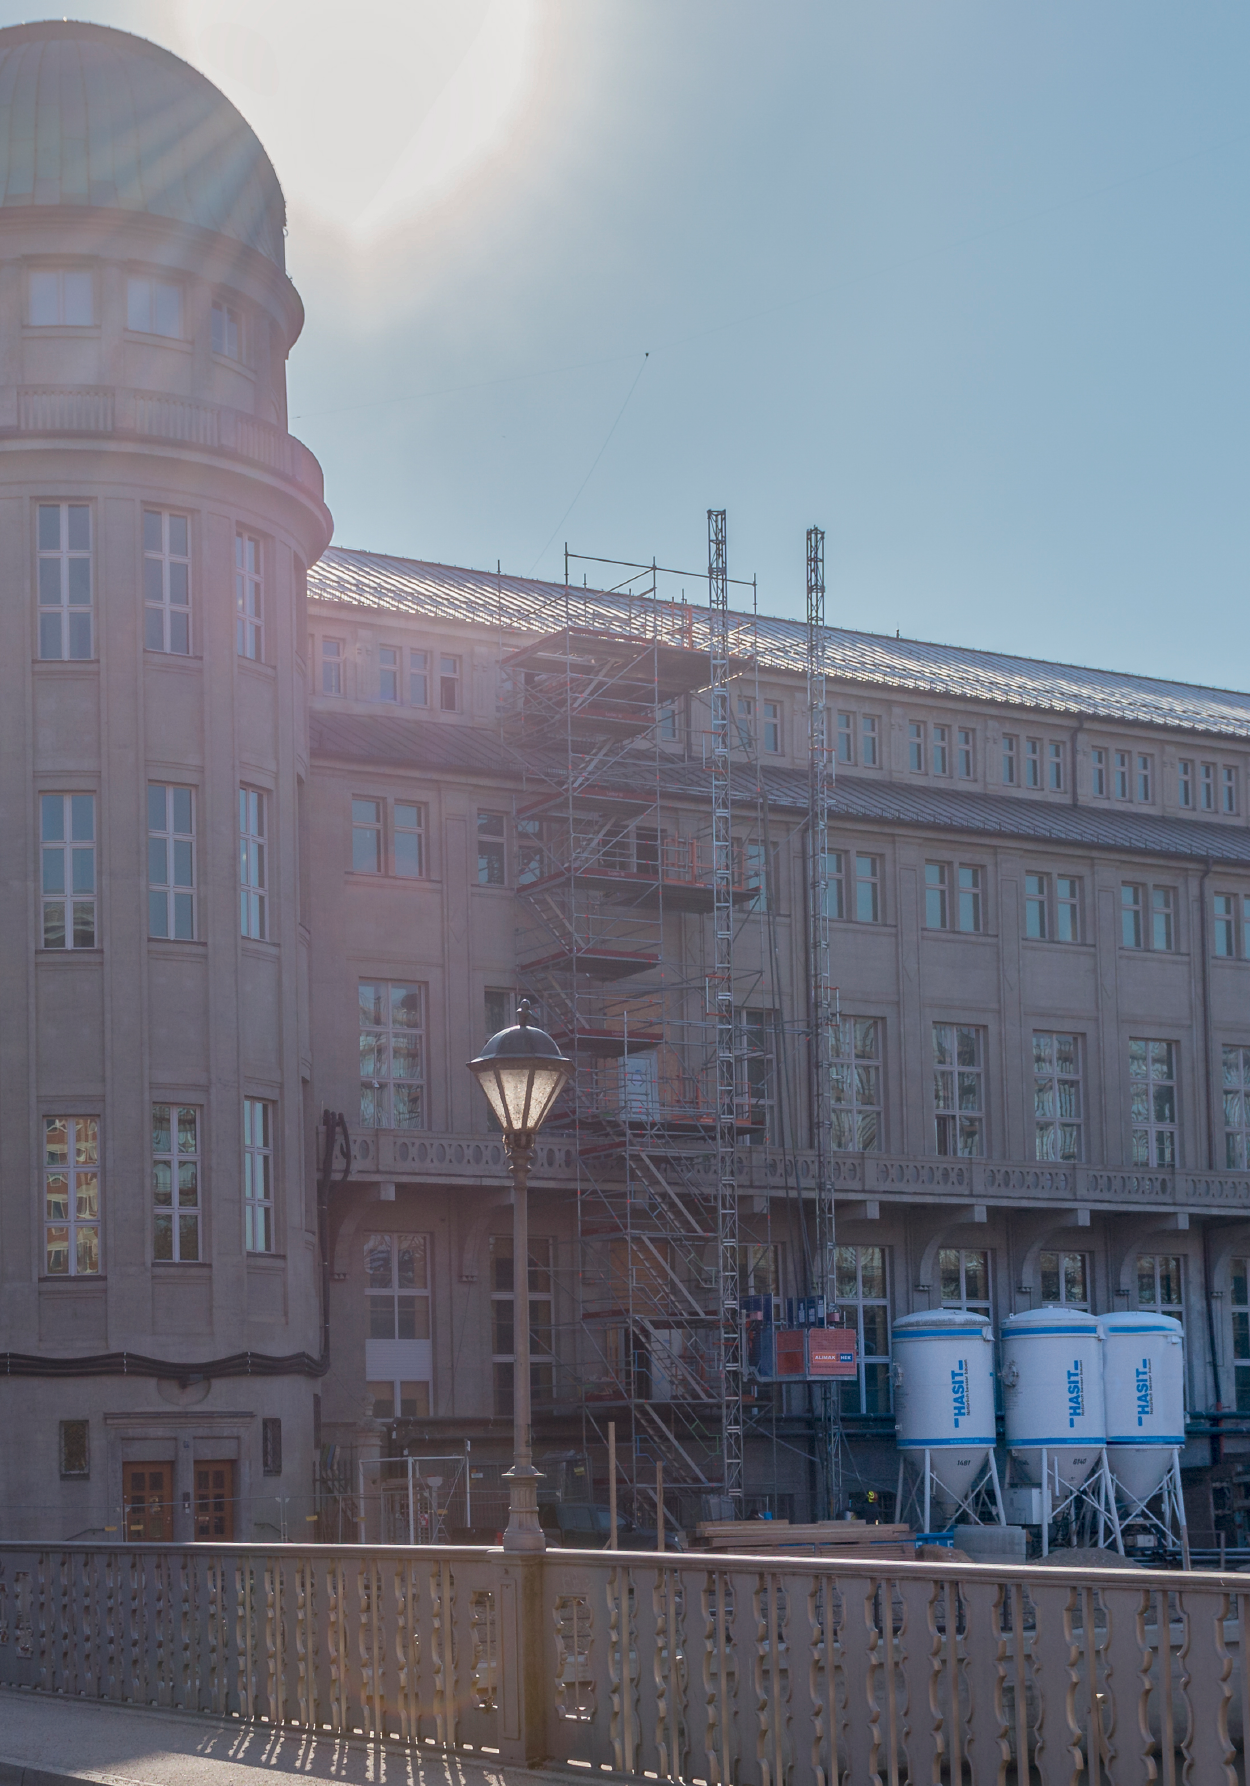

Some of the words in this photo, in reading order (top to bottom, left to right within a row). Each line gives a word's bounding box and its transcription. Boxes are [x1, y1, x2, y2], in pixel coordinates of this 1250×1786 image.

[951, 1370, 966, 1417] HASIT
[1067, 1370, 1082, 1417] HASIT
[1135, 1368, 1150, 1415] HASIT
